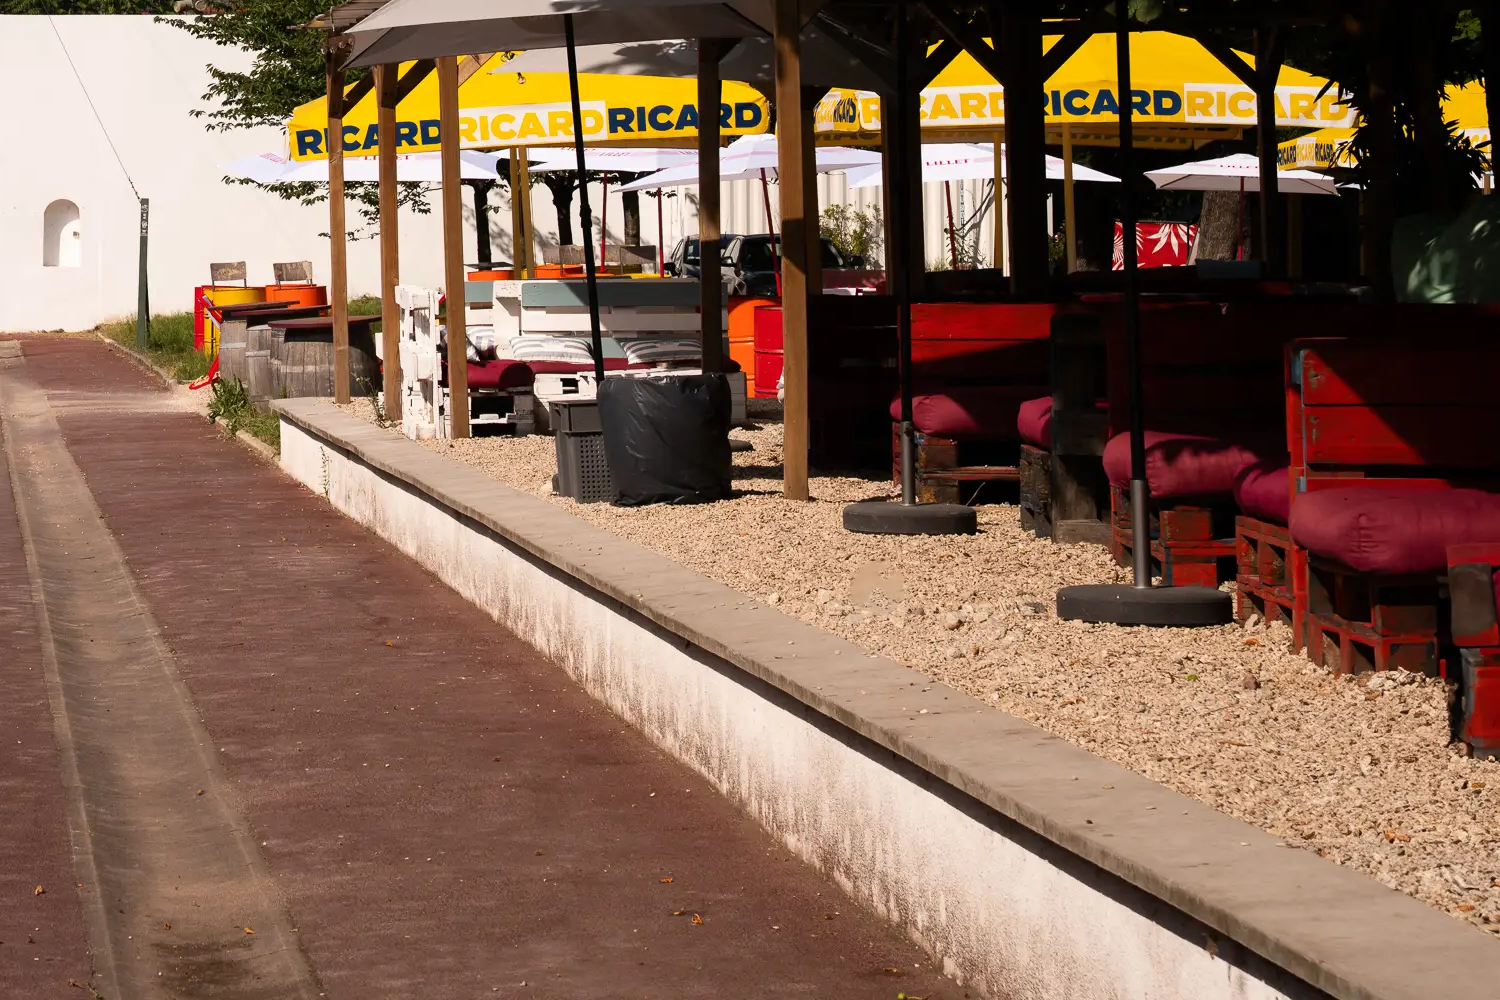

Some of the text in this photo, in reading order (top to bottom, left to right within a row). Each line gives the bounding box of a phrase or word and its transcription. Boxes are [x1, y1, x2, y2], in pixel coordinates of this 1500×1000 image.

[860, 92, 1005, 123] RARD
[1044, 89, 1182, 117] ICARD
[459, 109, 604, 142] RICARD
[926, 158, 970, 166] LILLET
